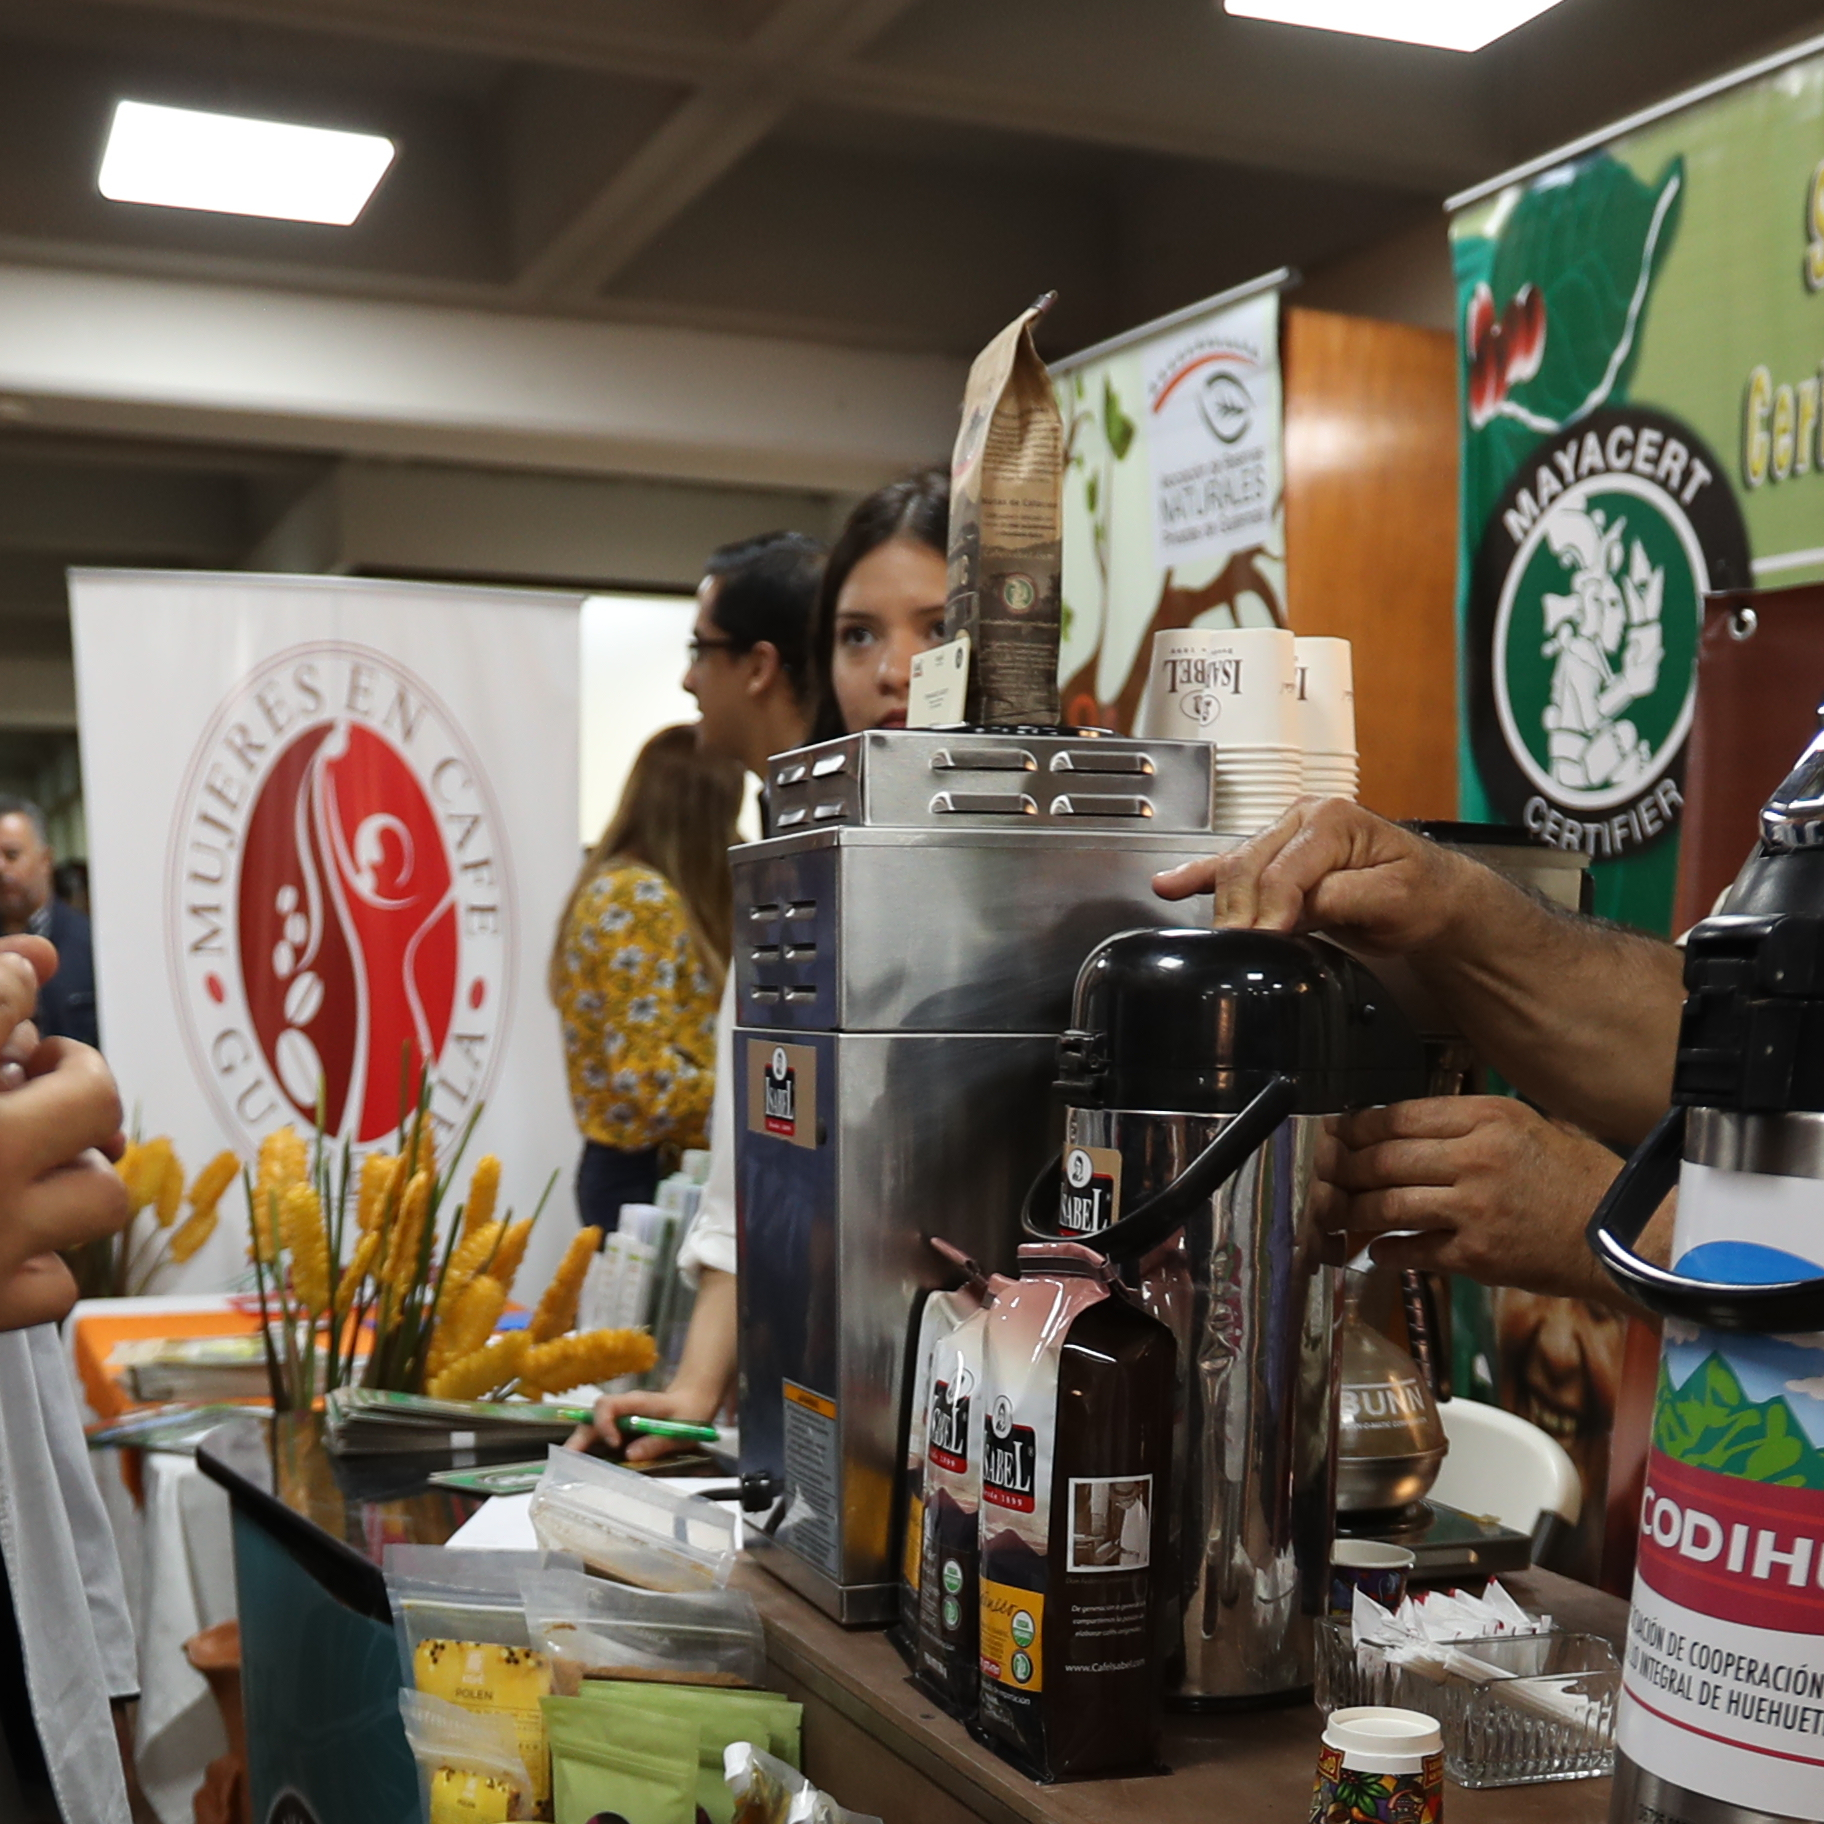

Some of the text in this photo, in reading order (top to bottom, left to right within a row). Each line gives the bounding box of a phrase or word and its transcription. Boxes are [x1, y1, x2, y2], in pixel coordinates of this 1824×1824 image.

[1504, 428, 1713, 545] MAYACERT
[188, 660, 499, 961] MUJERES EN CAFE
[1522, 776, 1685, 858] CERTIFIER
[1340, 1385, 1426, 1416] BUNN
[1667, 1630, 1686, 1661] DE
[454, 1686, 495, 1701] POLEN
[1639, 1651, 1693, 1702] INTEGRAL
[1698, 1679, 1720, 1711] DE
